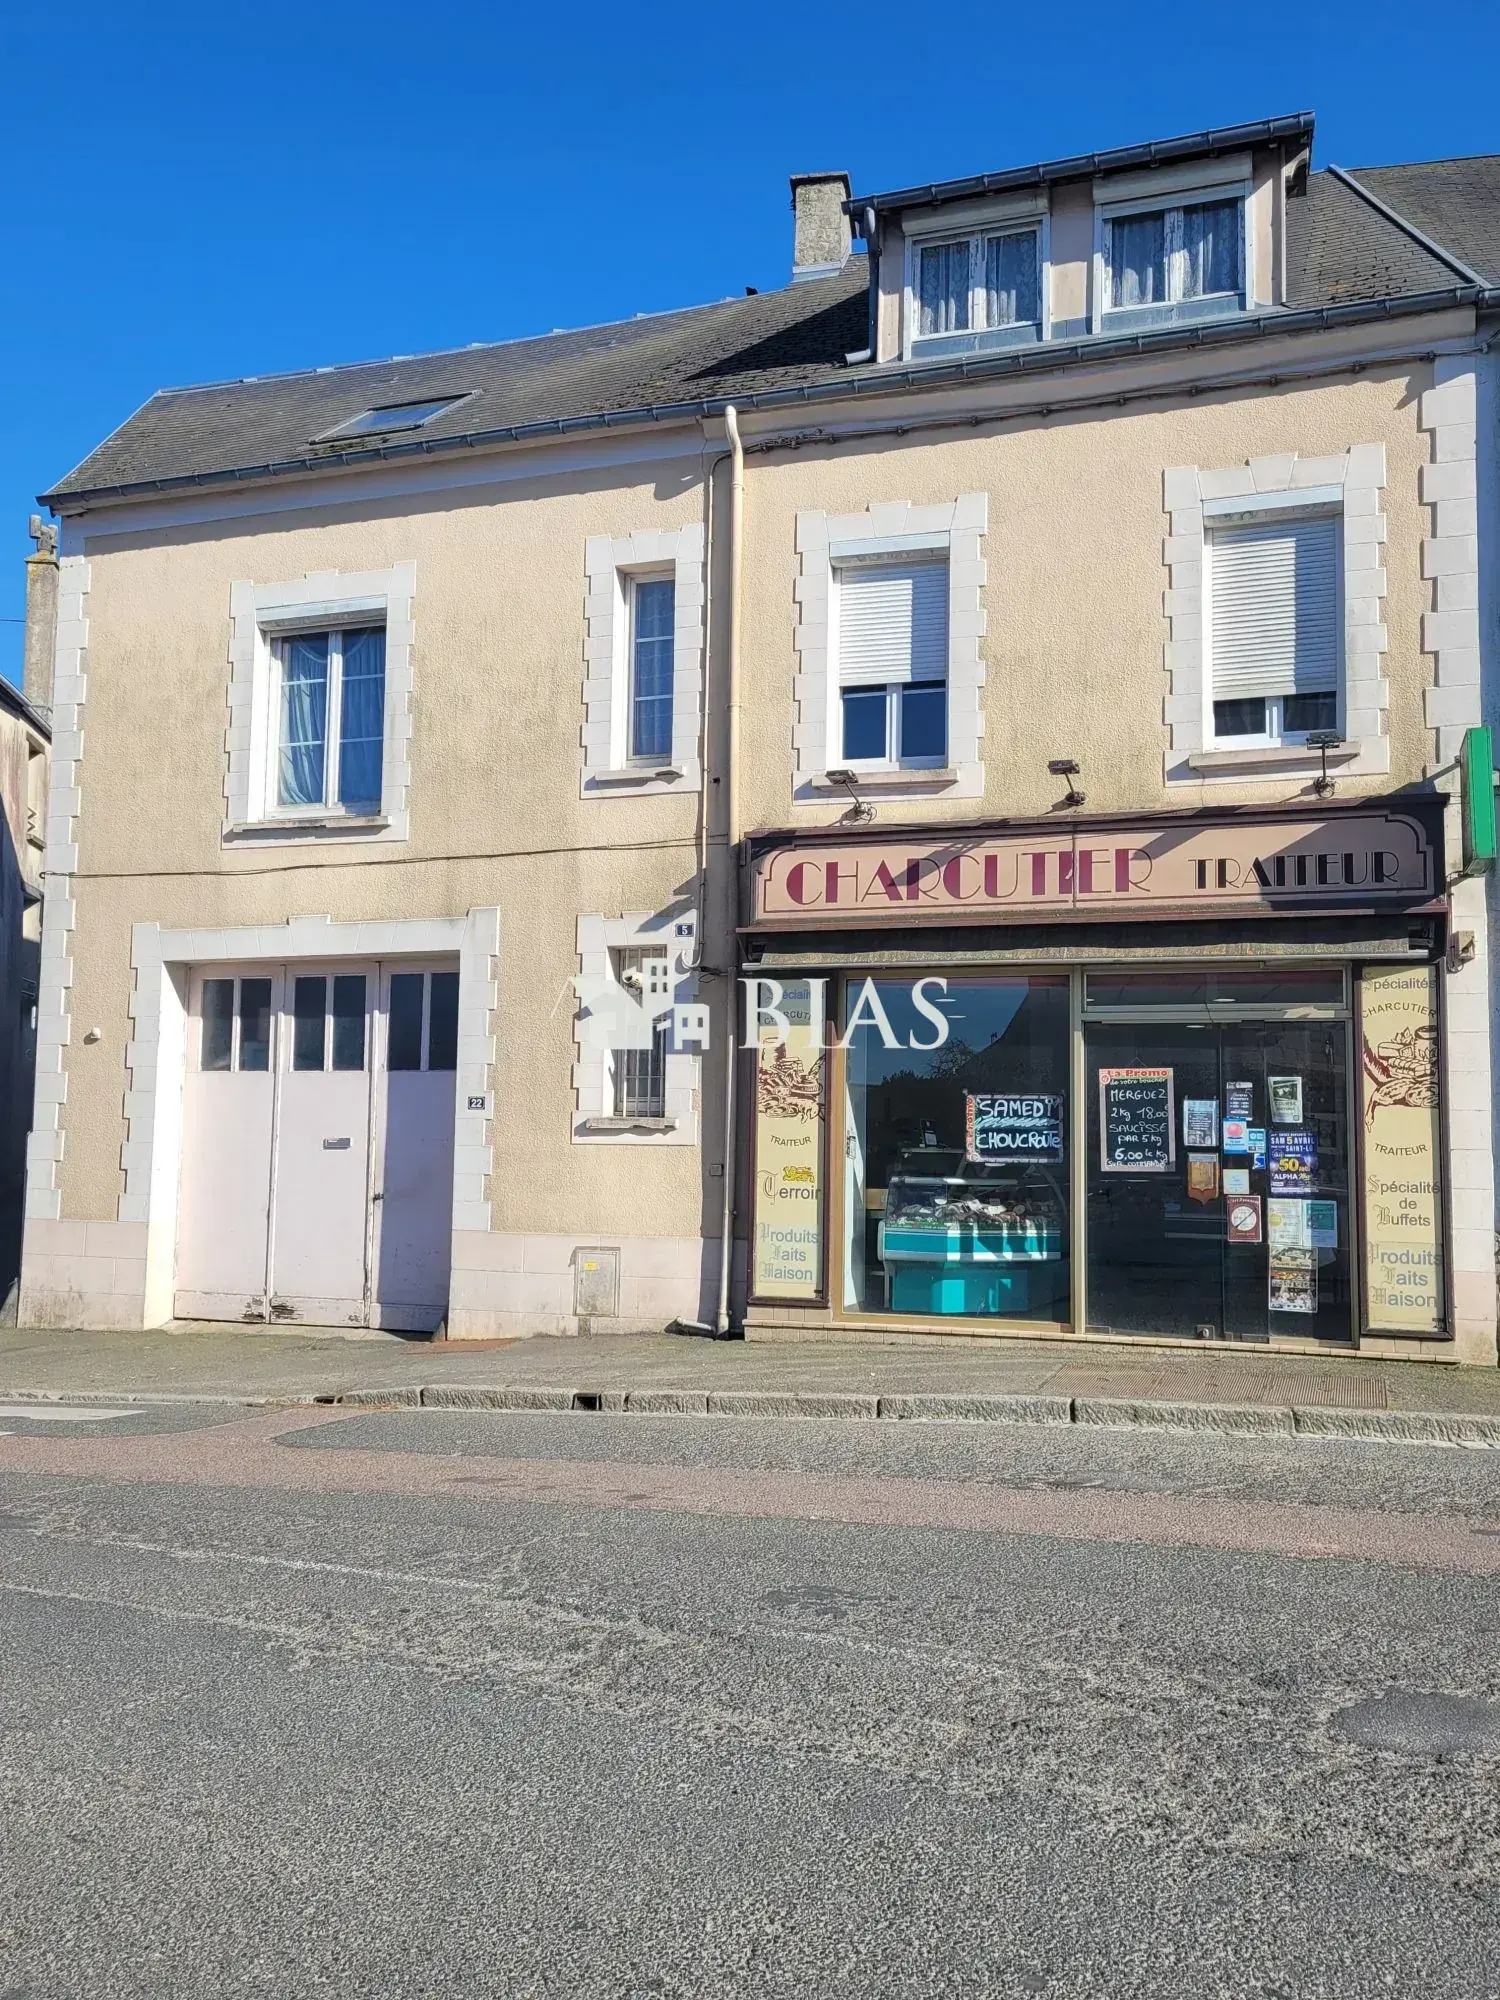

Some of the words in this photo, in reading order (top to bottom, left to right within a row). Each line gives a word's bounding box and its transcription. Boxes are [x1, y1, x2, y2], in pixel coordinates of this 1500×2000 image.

[786, 848, 1151, 905] CHARCUTIER
[1188, 850, 1399, 890] TRAITEUR
[681, 925, 688, 935] 5
[1362, 1002, 1436, 1019] CHARCUTIER
[1107, 1070, 1121, 1078] La
[1126, 1069, 1168, 1077] Promo
[1120, 1077, 1137, 1085] votre
[470, 1098, 482, 1108] 22
[1110, 1088, 1168, 1102] MERGUEZ
[770, 1134, 811, 1147] TRAITEUR
[1286, 1136, 1293, 1145] 5
[1294, 1136, 1315, 1145] AVRIL
[1374, 1142, 1428, 1156] TRAITEUR
[1279, 1158, 1299, 1171] 50
[757, 1169, 822, 1205] Terroir
[1367, 1174, 1441, 1196] Spécialité
[1399, 1197, 1417, 1209] de
[1373, 1204, 1431, 1230] Buffets
[759, 1222, 820, 1243] Produits
[769, 1243, 807, 1262] Faits
[1368, 1241, 1444, 1265] Produits
[759, 1261, 813, 1280] Maison
[1380, 1266, 1429, 1289] Faits
[1369, 1286, 1438, 1308] Maison
